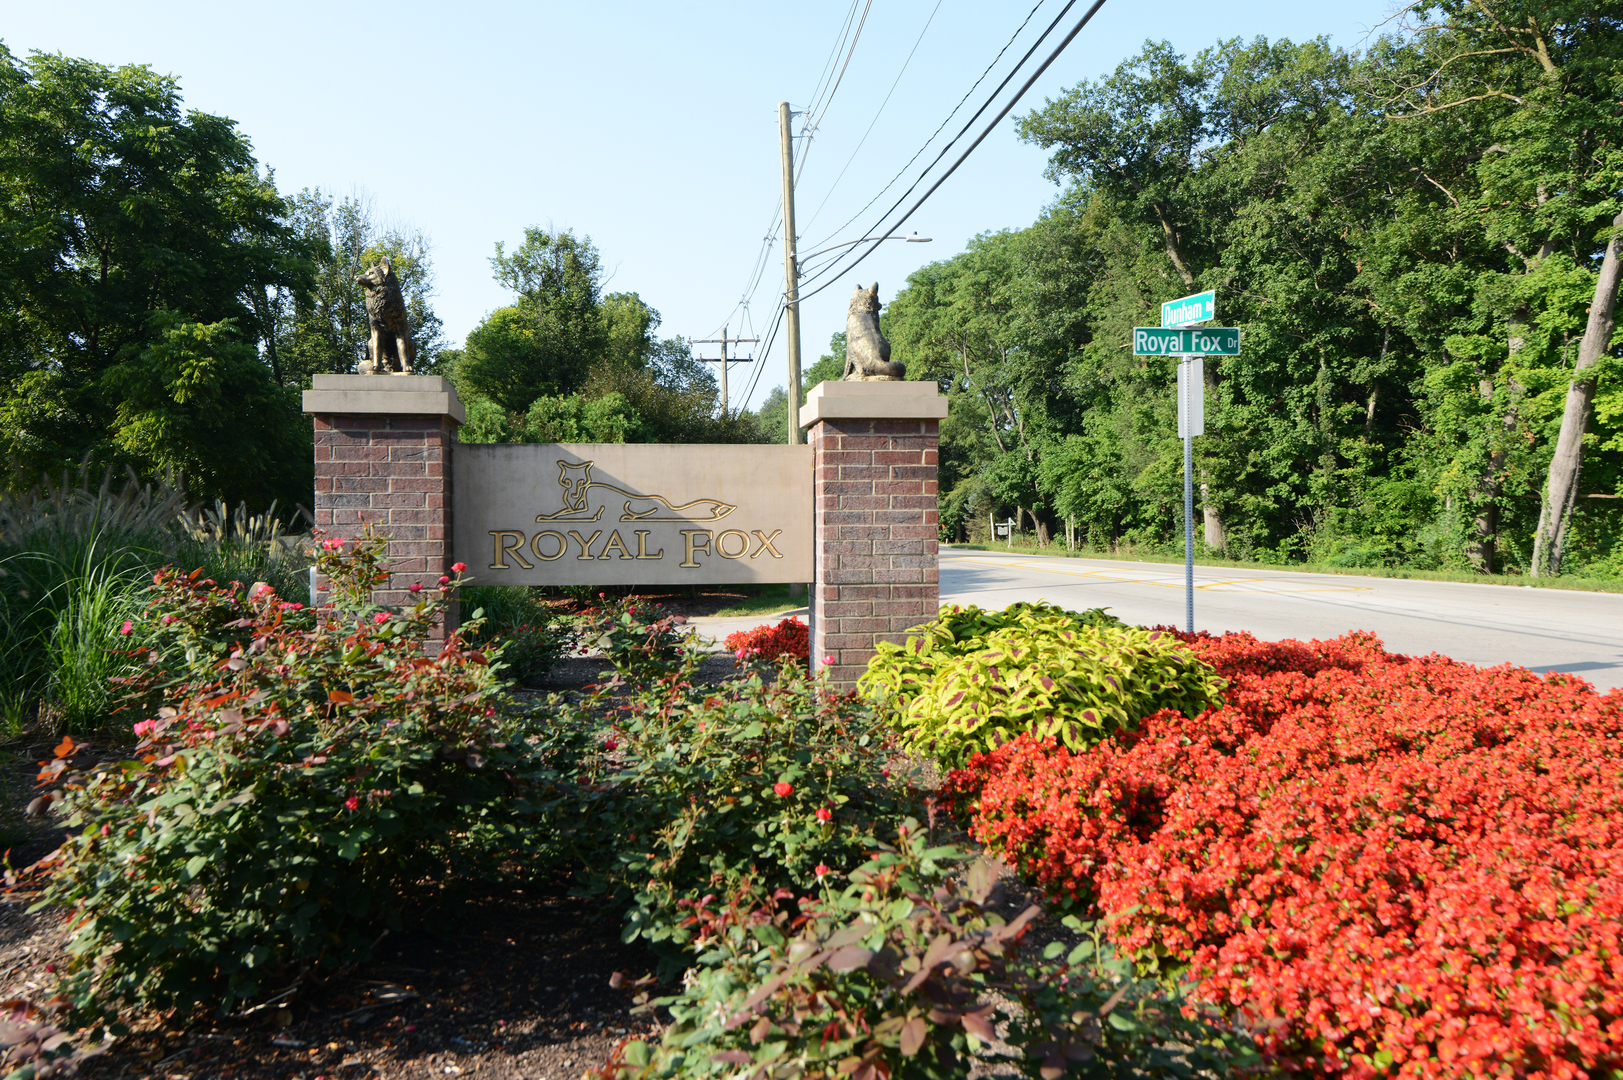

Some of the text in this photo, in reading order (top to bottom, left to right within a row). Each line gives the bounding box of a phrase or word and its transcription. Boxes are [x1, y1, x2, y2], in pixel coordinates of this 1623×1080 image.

[1164, 302, 1202, 326] Dunham
[1136, 331, 1238, 354] Royal Fox Dr
[488, 529, 783, 569] ROYAL FOX
